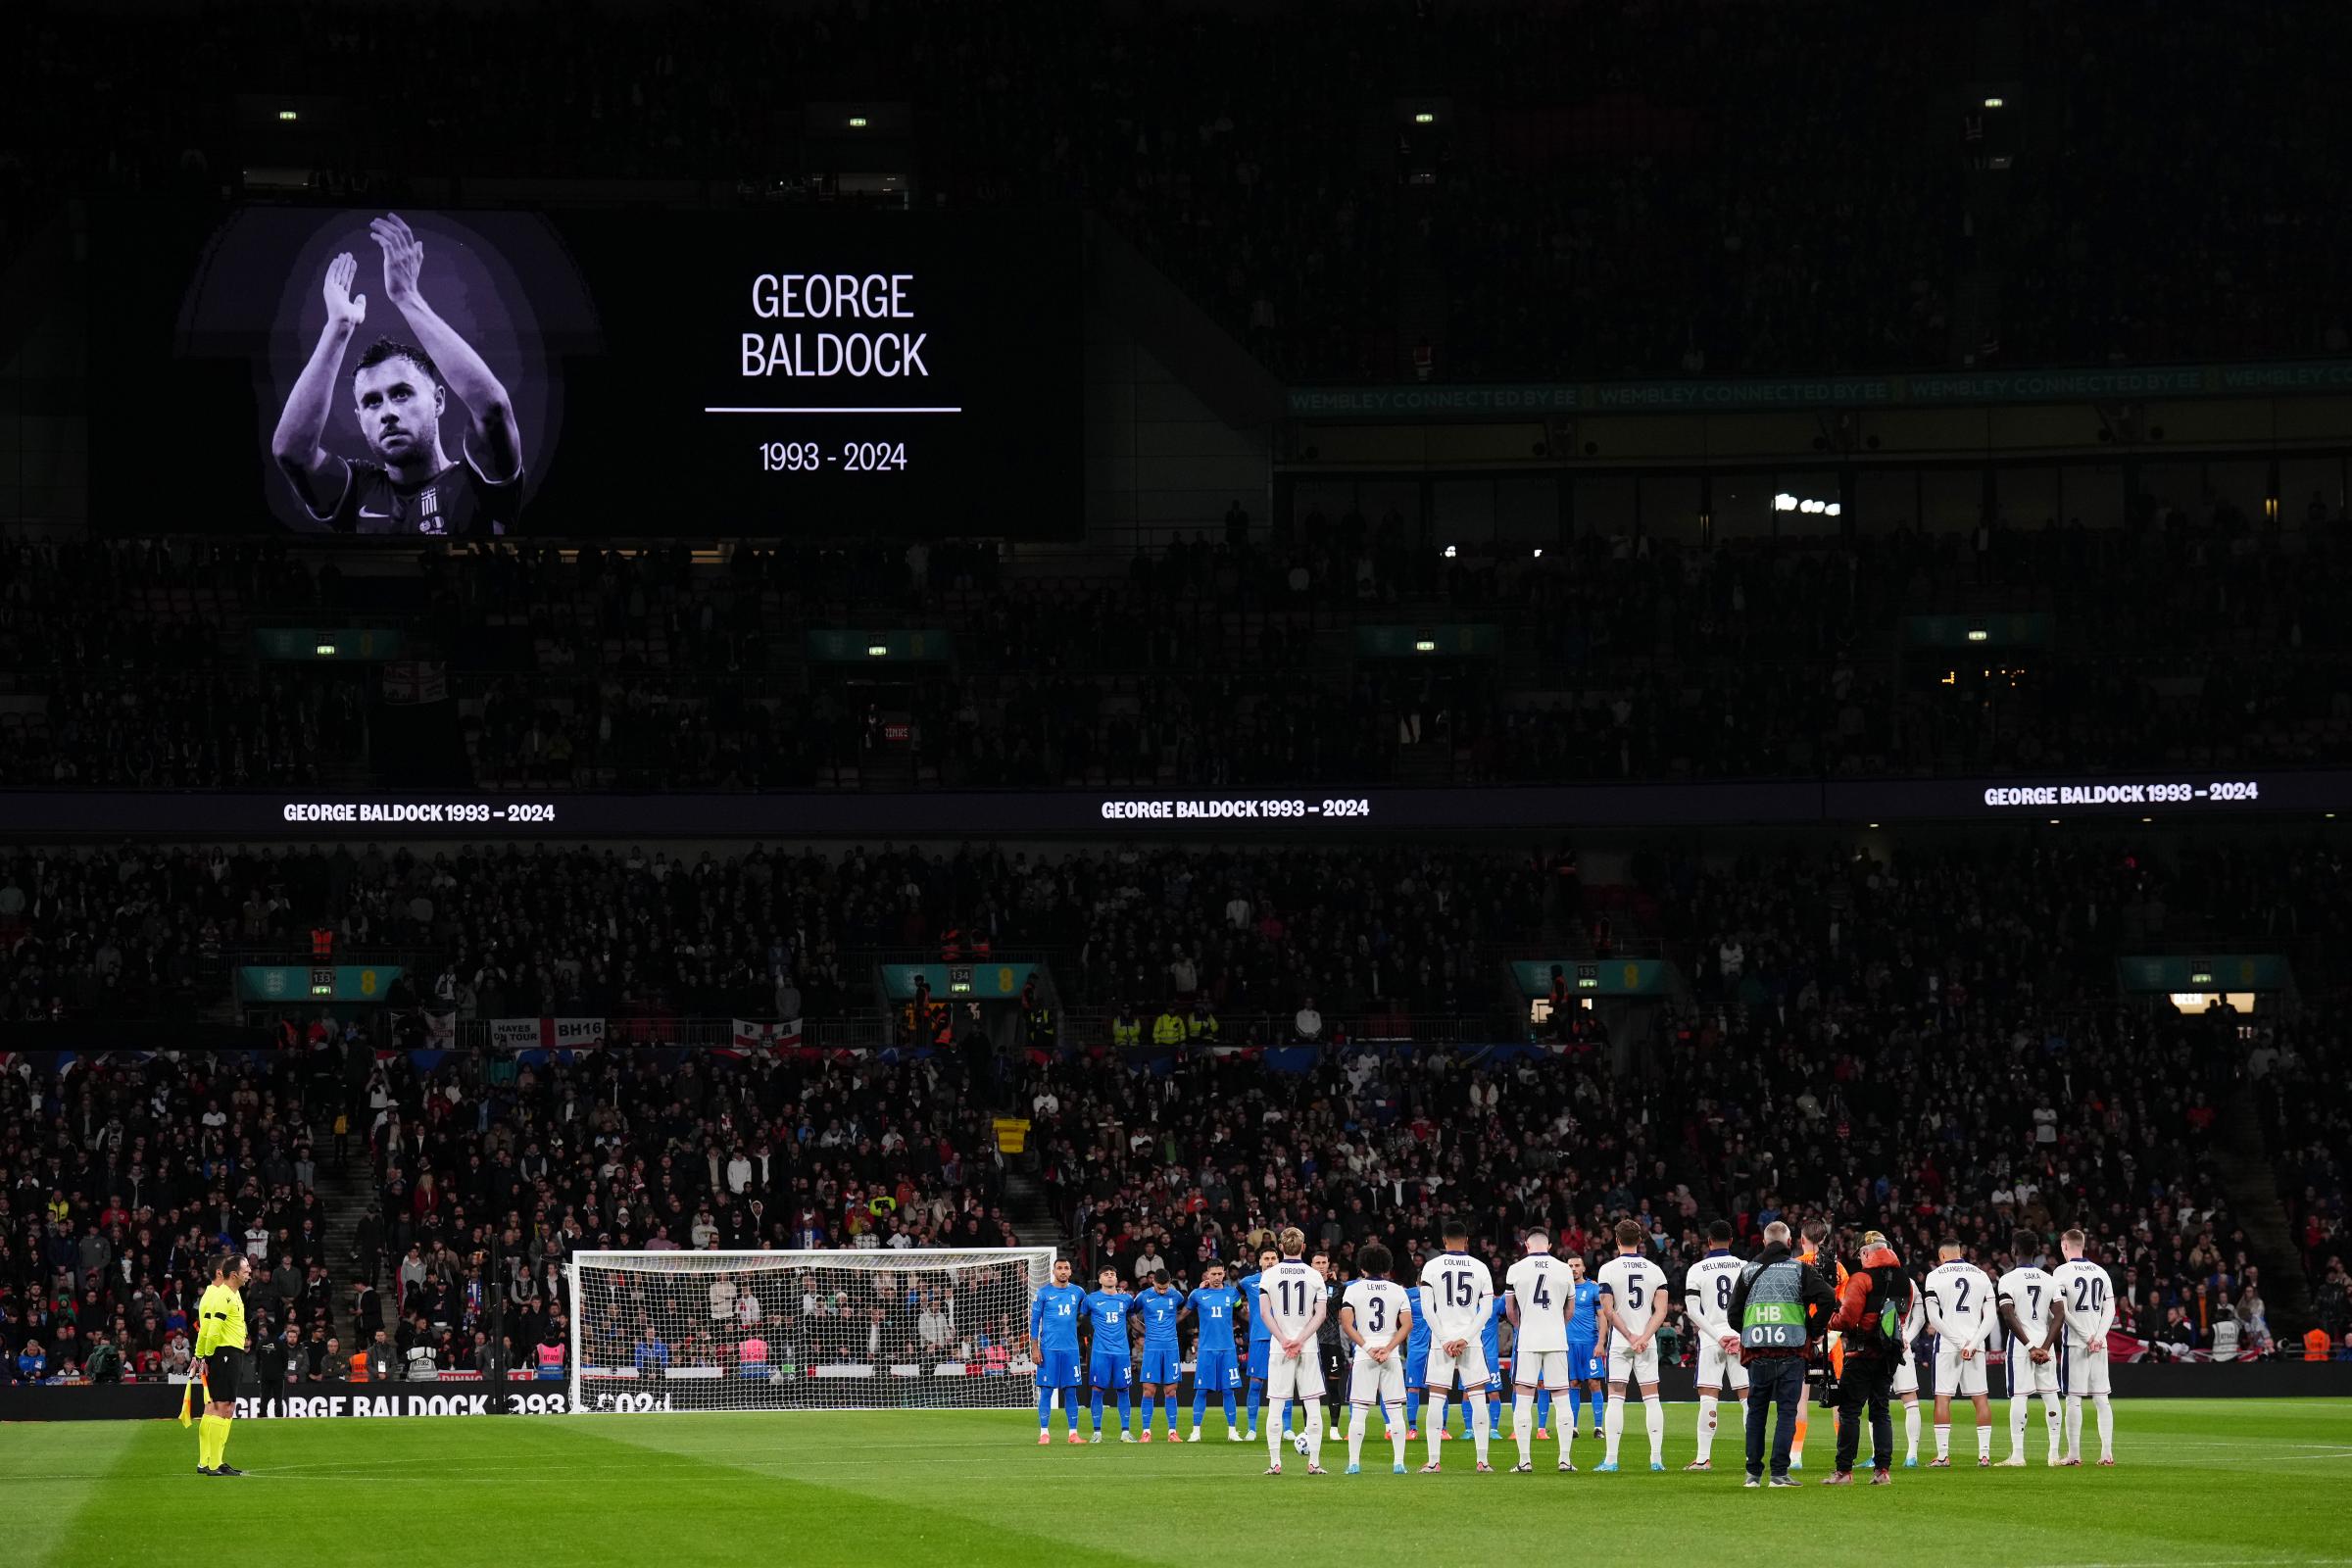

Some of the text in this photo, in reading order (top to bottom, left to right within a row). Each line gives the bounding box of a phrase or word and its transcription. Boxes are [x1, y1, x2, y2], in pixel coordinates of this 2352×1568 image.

[752, 273, 914, 318] GEORGE
[742, 332, 929, 377] BALDOCK
[1599, 382, 1886, 405] WEMBLEY CONNECTED BY EE
[1911, 372, 2200, 397] WEMBLEY CONNECTED BY EE
[1292, 389, 1576, 409] WEMBLEY CONNECTED BY EE
[760, 442, 819, 471] 1993
[844, 442, 907, 471] 2024
[1984, 787, 2058, 806] GEORGE
[2061, 785, 2145, 805] BALDOCK
[2145, 784, 2192, 802] 1993
[2210, 782, 2259, 801] 2024
[283, 804, 357, 822] GEORGE
[360, 804, 444, 822] BALDOCK
[444, 804, 490, 822] 1993
[508, 804, 556, 822] 2024
[1102, 801, 1174, 819] GEORGE
[1176, 801, 1258, 818] BALDOCK
[1259, 800, 1305, 817] 1993
[1322, 799, 1370, 817] 2024
[314, 973, 331, 983] 133
[952, 971, 969, 982] 134
[1579, 966, 1596, 978] 135
[498, 1024, 531, 1033] HAYES
[559, 1022, 602, 1037] BH16
[1444, 1258, 1472, 1267] COLWILL
[1702, 1261, 1741, 1272] BELLINGHAM
[1441, 1270, 1474, 1307] 15
[1533, 1273, 1551, 1310] 4
[1628, 1274, 1644, 1310] 5
[1716, 1274, 1732, 1310] 8
[1954, 1277, 1971, 1313] 2
[2074, 1276, 2104, 1312] 20
[1278, 1280, 1307, 1316] 11
[2027, 1285, 2042, 1320] 7
[1057, 1303, 1071, 1316] 14
[1105, 1311, 1118, 1324] 15
[1156, 1309, 1164, 1321] 7
[1210, 1306, 1223, 1318] 11
[1368, 1297, 1385, 1332] 3
[1755, 1305, 1782, 1322] HB
[1751, 1326, 1786, 1344] 016
[1172, 1362, 1179, 1374] 7
[1332, 1356, 1339, 1367] 1
[1590, 1359, 1597, 1370] 6
[1228, 1367, 1240, 1380] 11
[1490, 1372, 1501, 1384] 23
[493, 1393, 565, 1415] 993
